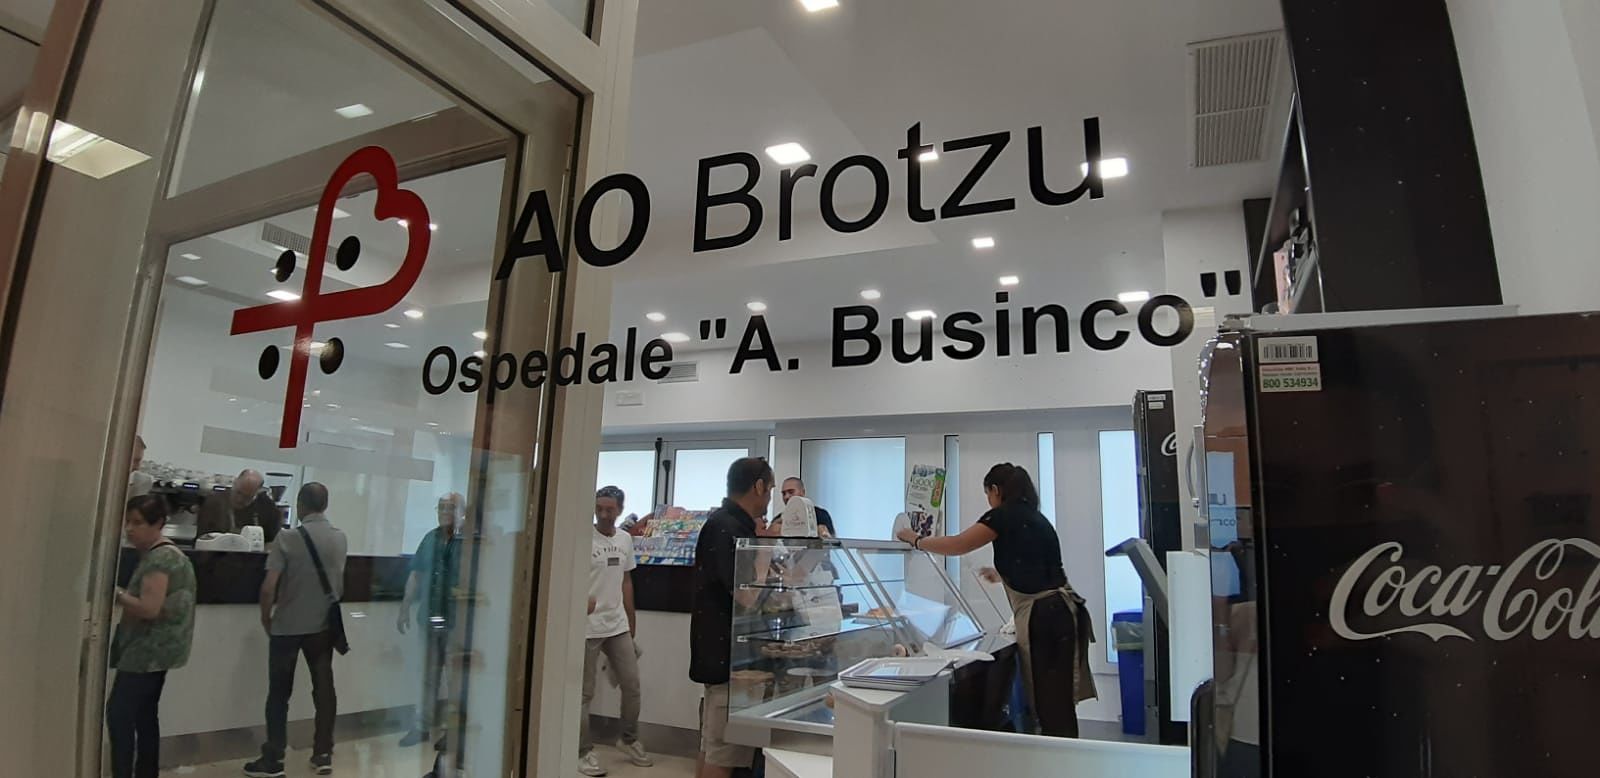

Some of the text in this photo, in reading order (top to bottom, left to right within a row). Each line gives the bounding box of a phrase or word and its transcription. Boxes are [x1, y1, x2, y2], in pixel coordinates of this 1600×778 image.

[495, 117, 1104, 281] AO Brotzu
[422, 270, 1241, 404] Ospedale "A. Businco"
[1263, 378, 1280, 388] 800
[1329, 537, 1600, 642] Coca-Col
